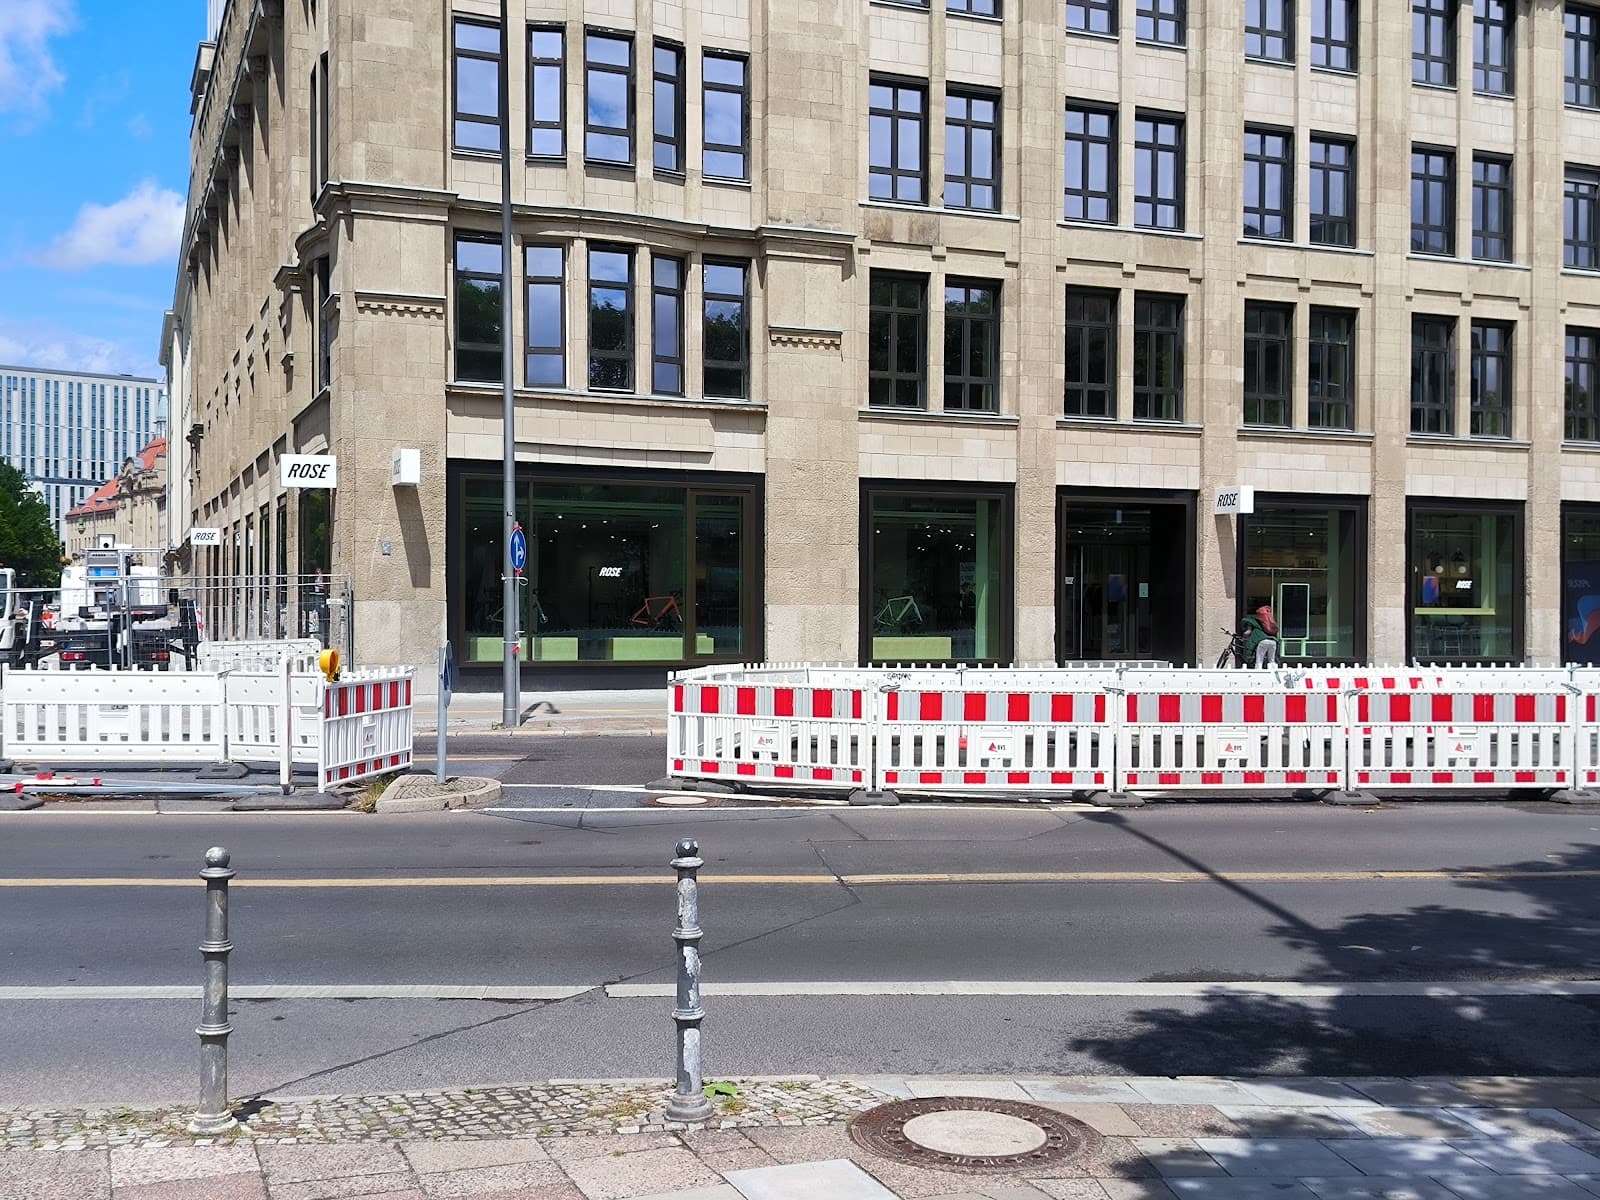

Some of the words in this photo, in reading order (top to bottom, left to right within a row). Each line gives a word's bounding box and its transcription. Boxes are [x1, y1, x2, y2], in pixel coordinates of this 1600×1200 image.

[287, 463, 331, 479] ROSE
[1217, 493, 1239, 507] ROSE
[193, 532, 217, 541] ROSE
[599, 567, 623, 577] ROSE
